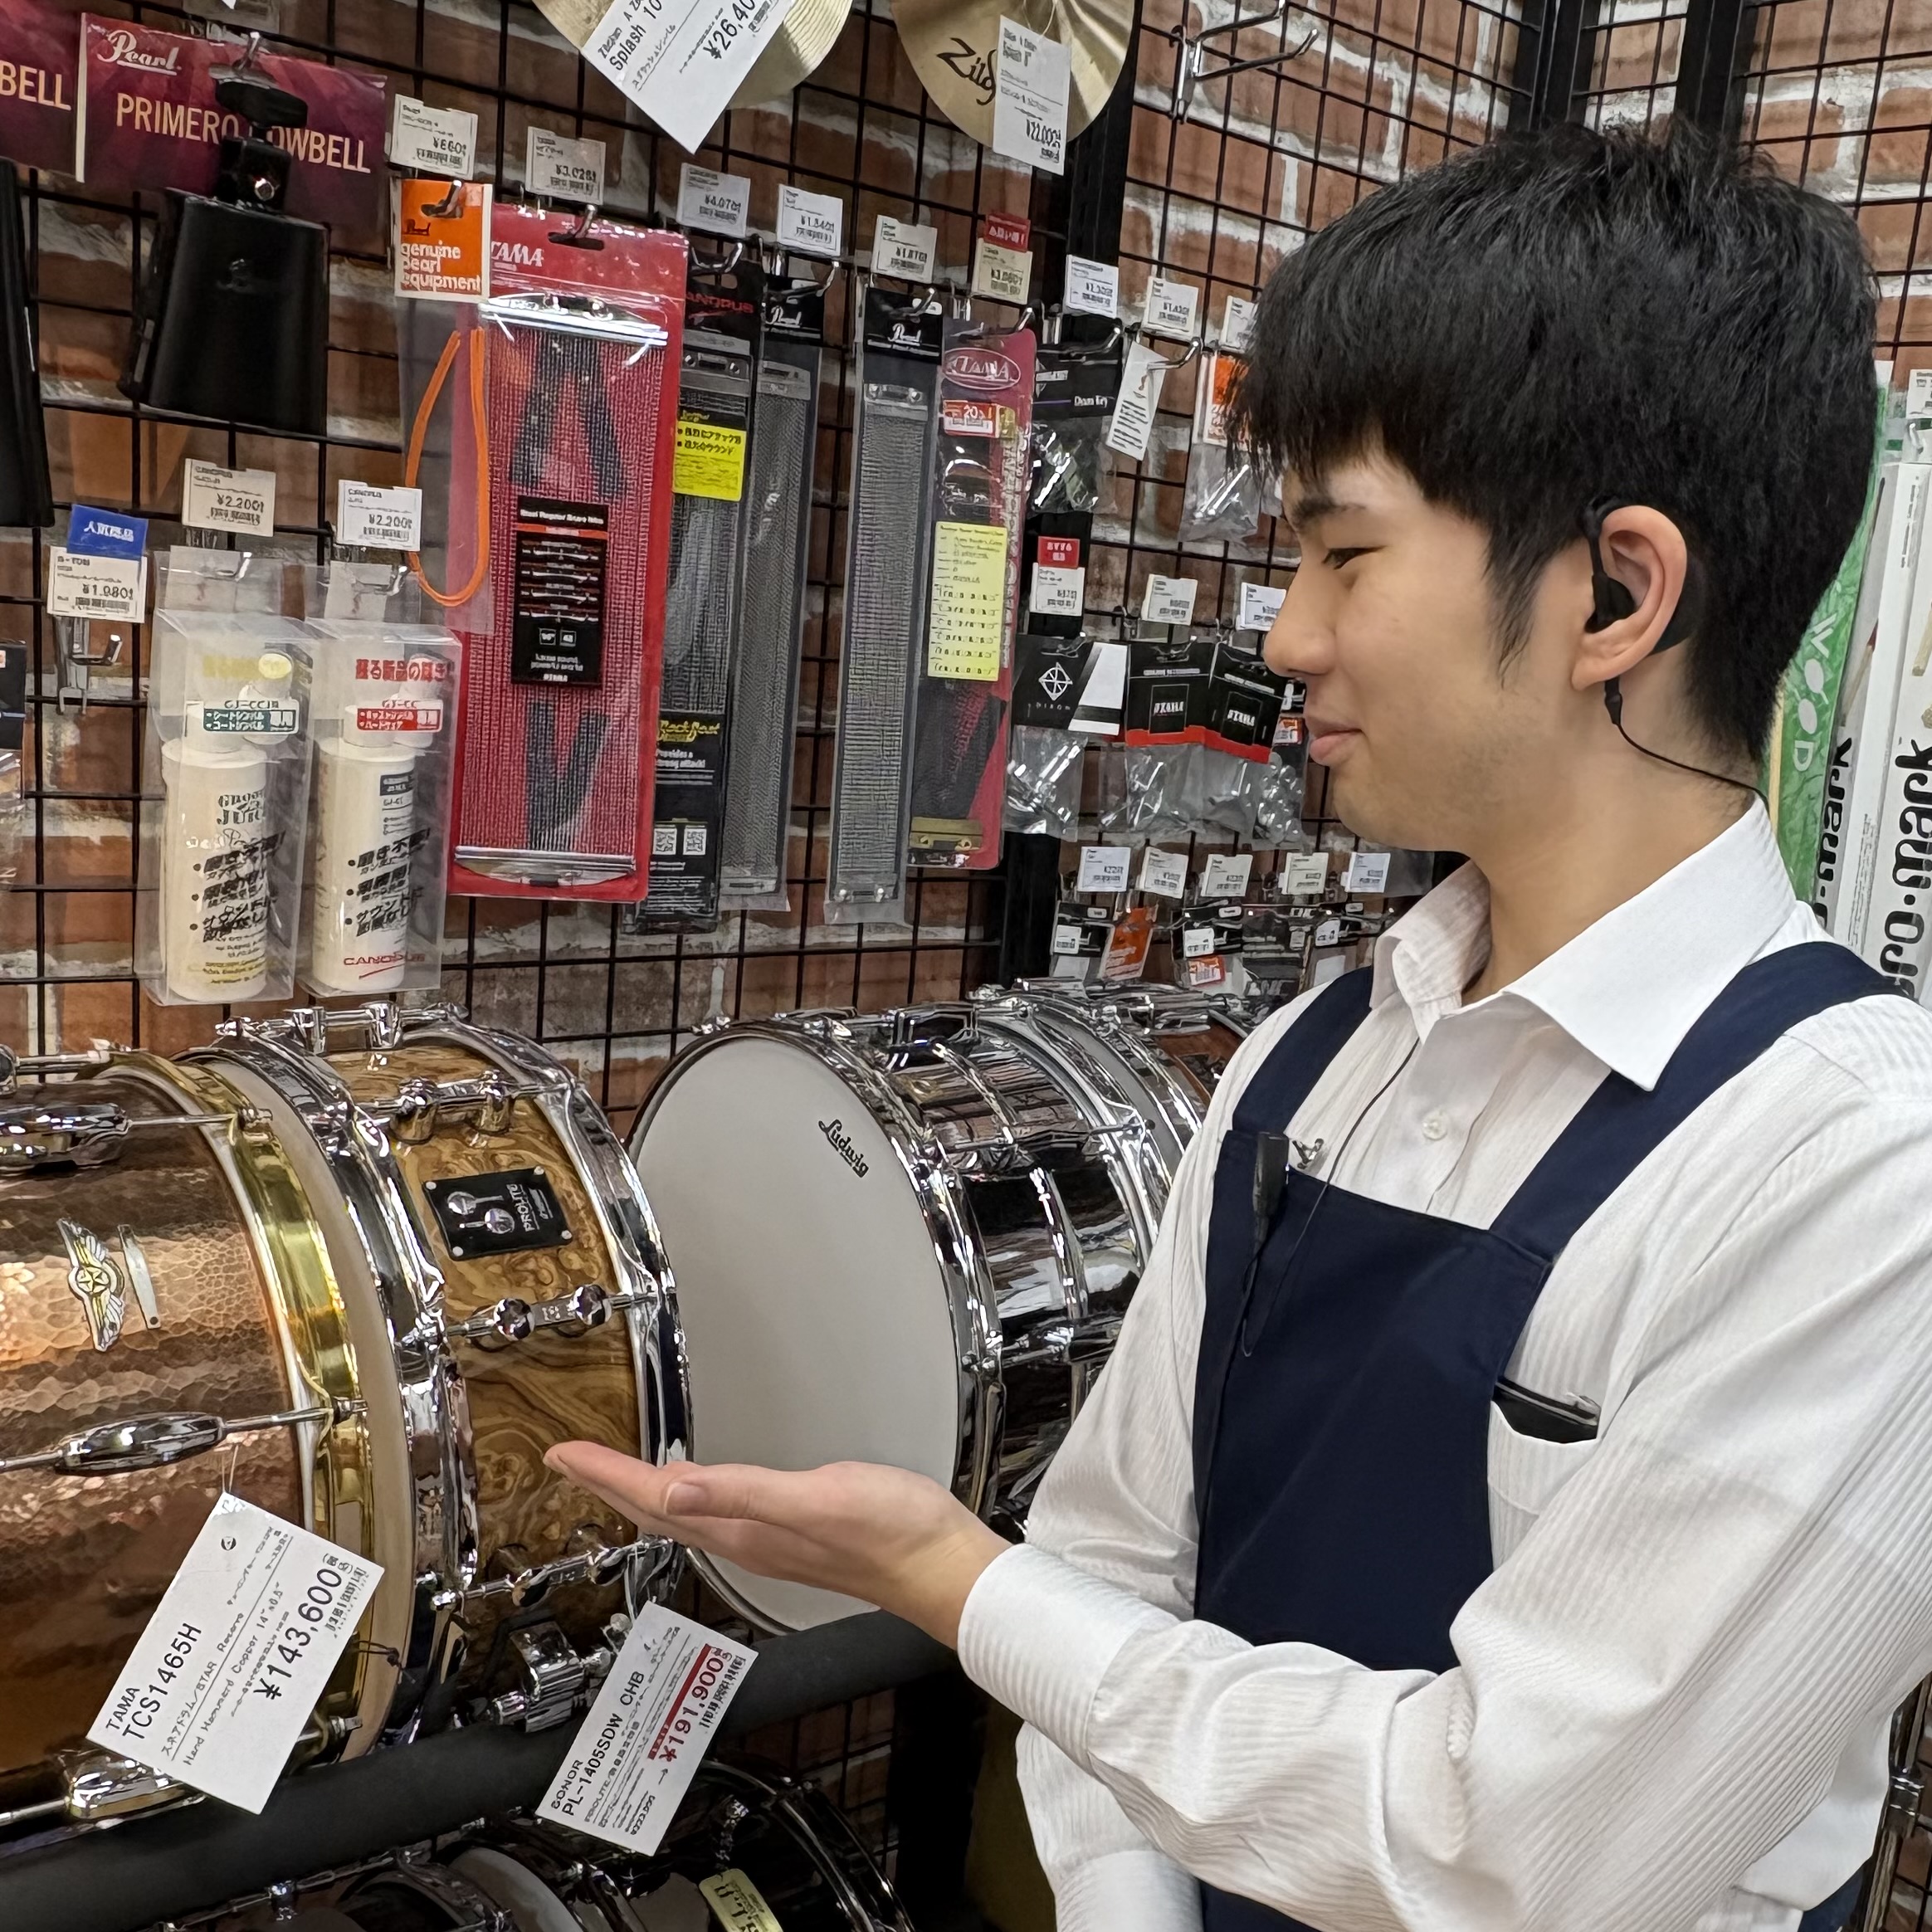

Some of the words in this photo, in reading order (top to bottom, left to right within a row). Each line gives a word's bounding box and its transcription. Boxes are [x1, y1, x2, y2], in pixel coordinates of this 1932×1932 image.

[97, 30, 181, 76] Pearl
[609, 23, 646, 71] Splash
[0, 60, 71, 110] BELL
[116, 93, 238, 144] PRIMERO
[250, 125, 371, 173] OWBELL
[401, 240, 461, 259] genuine
[402, 255, 441, 272] pearl
[401, 273, 481, 292] equipment
[818, 1119, 869, 1178] Ludwig
[253, 1567, 342, 1701] ¥143,600
[122, 1622, 202, 1739] TCS1465H
[105, 1686, 140, 1730] TAMA
[562, 1713, 623, 1816] PL-1405SDW
[620, 1671, 645, 1706] CHB
